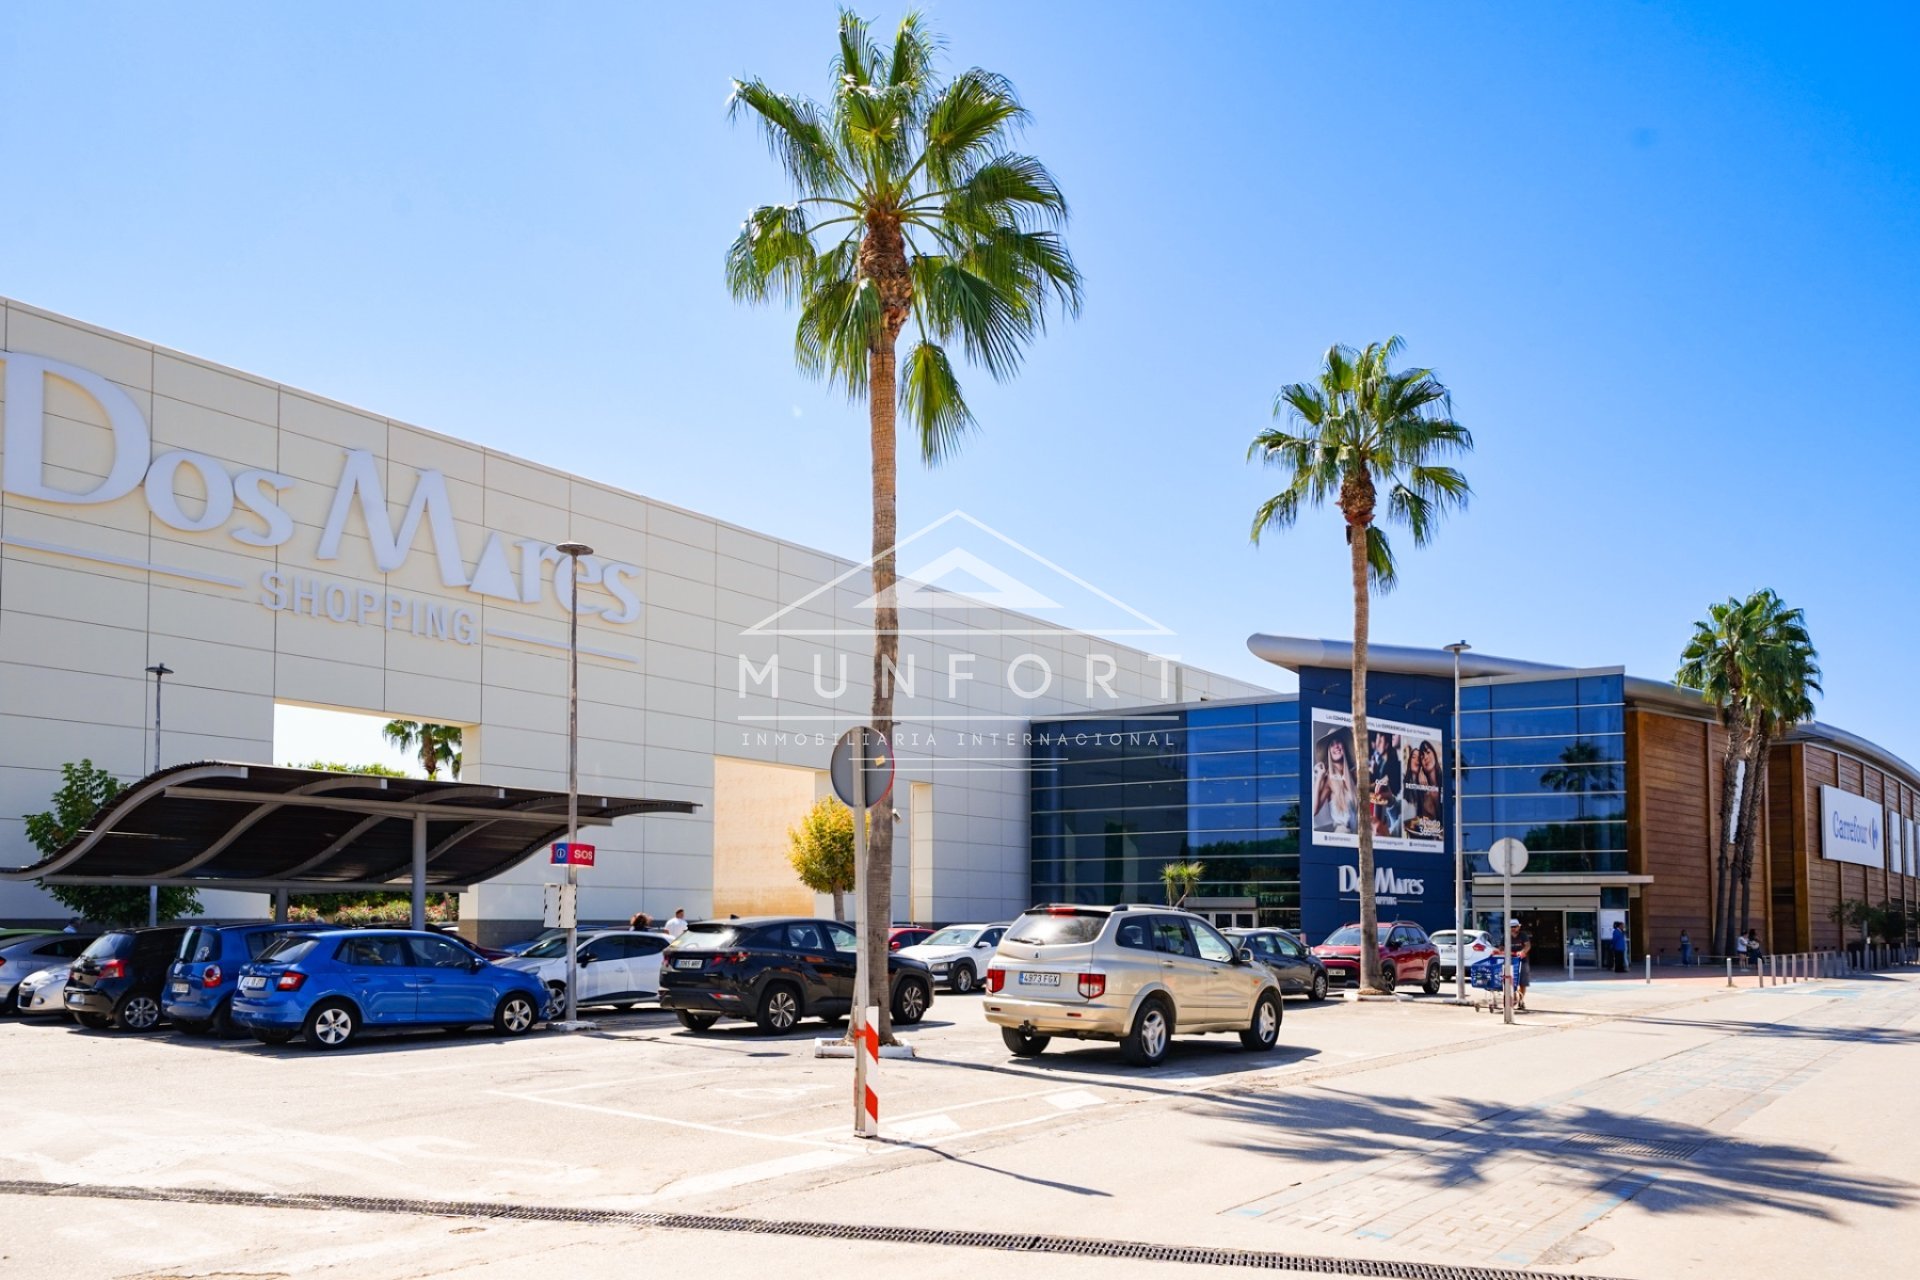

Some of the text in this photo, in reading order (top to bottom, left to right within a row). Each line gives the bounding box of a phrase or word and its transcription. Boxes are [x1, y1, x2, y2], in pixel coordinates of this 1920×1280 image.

[1, 351, 641, 624] Dos Mares
[260, 570, 478, 645] SHOPPING
[574, 849, 593, 860] SOS
[1833, 811, 1868, 844] Carrefour
